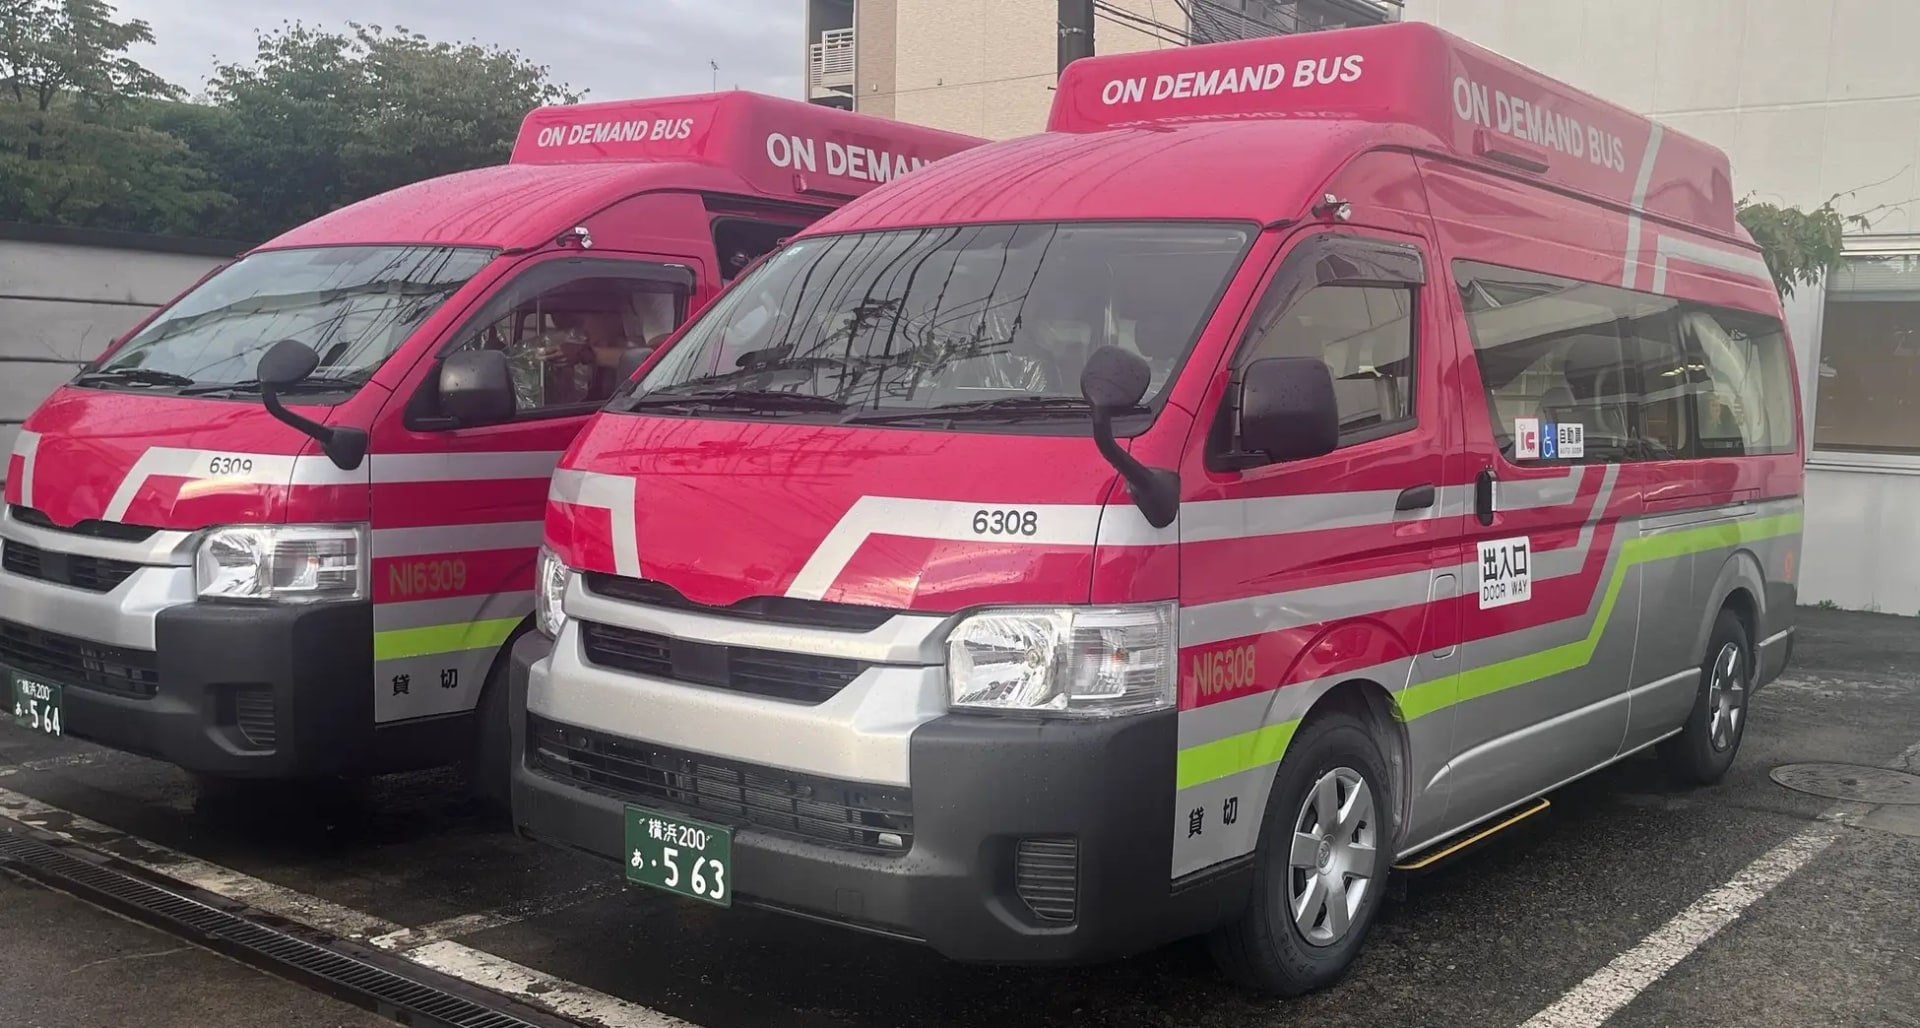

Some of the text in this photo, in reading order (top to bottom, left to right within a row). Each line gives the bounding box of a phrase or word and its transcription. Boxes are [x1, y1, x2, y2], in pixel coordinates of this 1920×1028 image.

[1102, 55, 1364, 105] ON DEMAND BUS
[537, 118, 694, 147] ON DEMAND BUS
[1453, 76, 1625, 173] ON DEMAND BUS
[766, 132, 937, 183] ON DEMA
[209, 456, 253, 475] 6309
[972, 509, 1038, 536] 6308
[1483, 544, 1527, 583] 出入口
[1483, 579, 1527, 602] DOOR WAY
